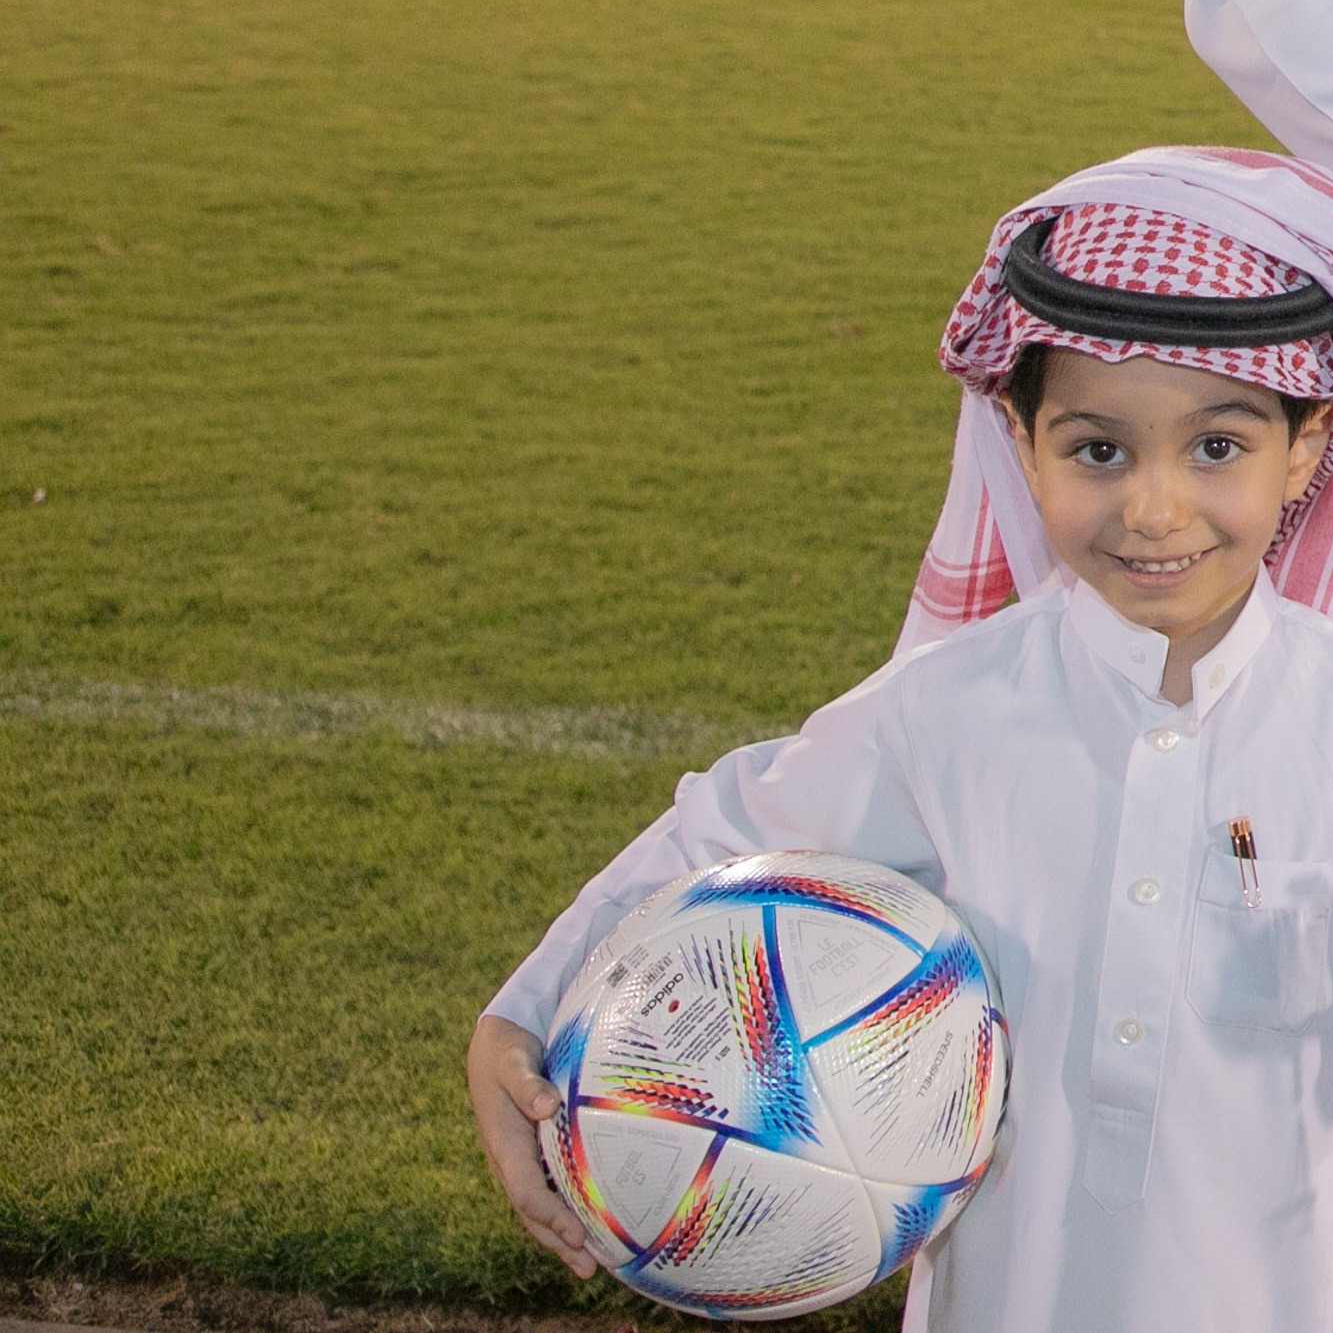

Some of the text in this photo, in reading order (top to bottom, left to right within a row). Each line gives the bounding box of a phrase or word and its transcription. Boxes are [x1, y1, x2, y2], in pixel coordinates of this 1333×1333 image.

[809, 937, 864, 976] FOOTBALL
[818, 937, 837, 954] LE
[641, 972, 685, 1017] adidas
[916, 1030, 954, 1098] SPEEDSHELL
[632, 1169, 647, 1187] ES
